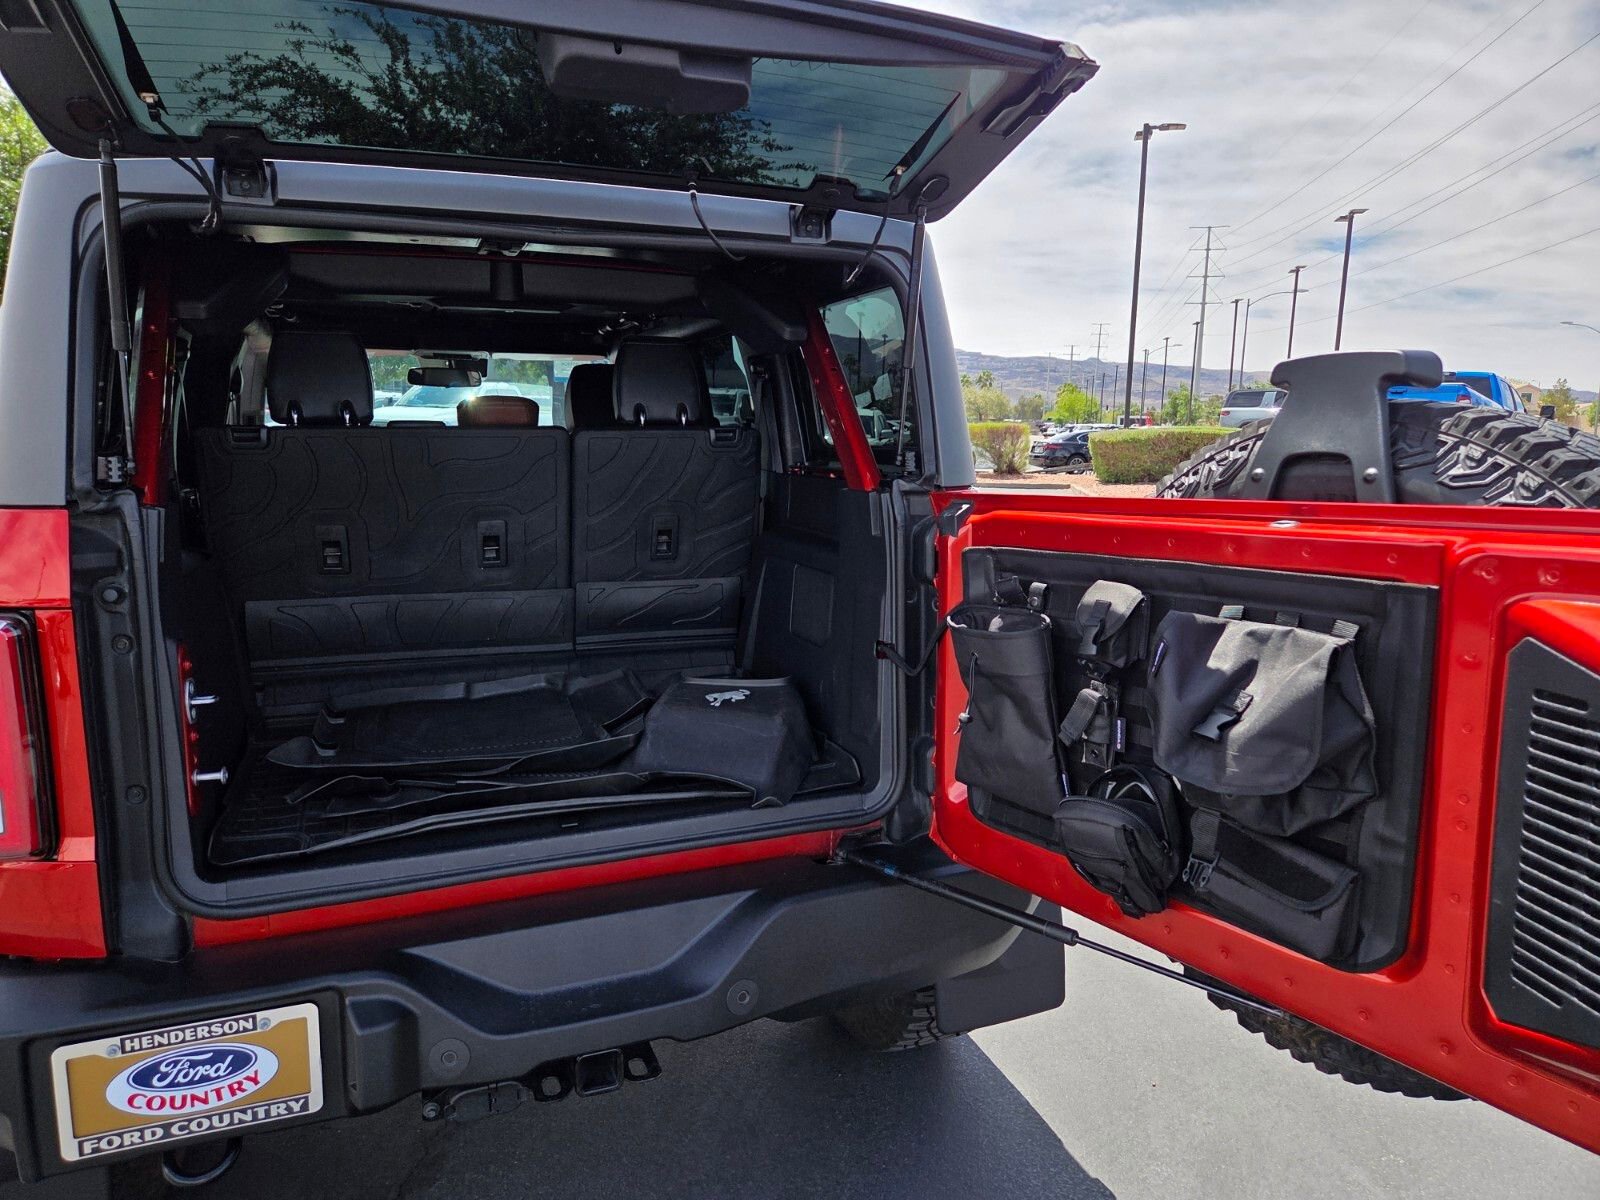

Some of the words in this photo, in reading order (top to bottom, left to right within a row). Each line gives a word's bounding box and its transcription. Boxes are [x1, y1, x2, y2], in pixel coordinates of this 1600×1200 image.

[123, 1017, 254, 1052] HENDERSON
[151, 1051, 232, 1088] Ford
[126, 1069, 262, 1112] COUNTRY
[82, 1127, 164, 1155] FORD
[170, 1098, 306, 1135] COUNTRY
